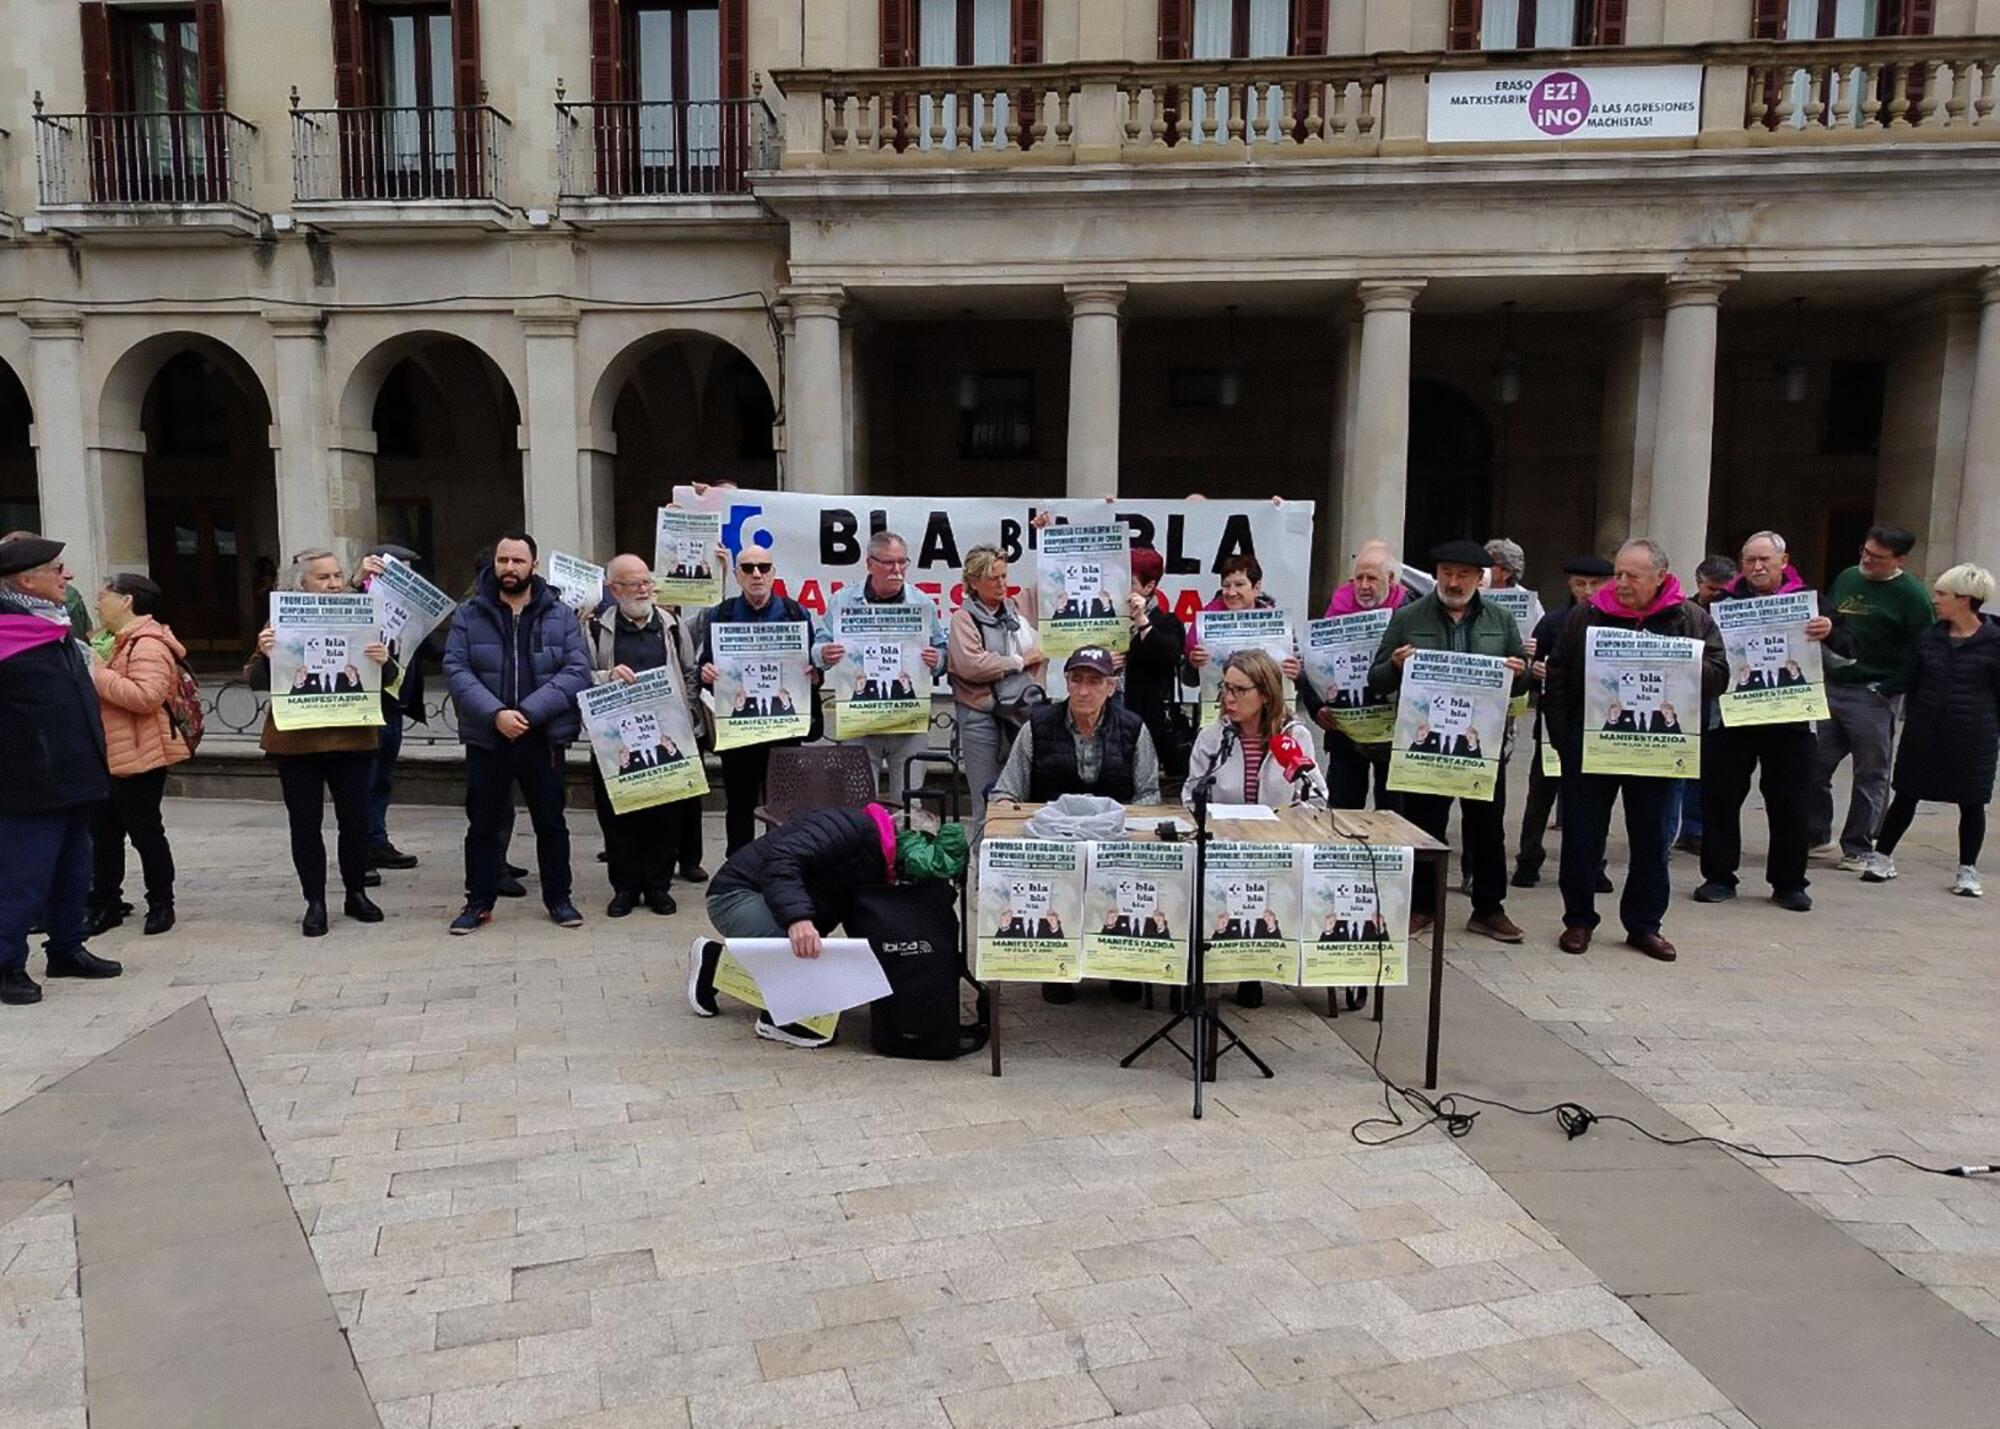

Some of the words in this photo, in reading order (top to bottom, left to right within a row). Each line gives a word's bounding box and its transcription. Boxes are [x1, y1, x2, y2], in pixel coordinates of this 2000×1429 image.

[1495, 80, 1533, 91] ERASO
[1543, 81, 1578, 101] EZ!
[1450, 94, 1528, 105] MATXISTARIK
[1591, 104, 1599, 114] A
[1602, 103, 1622, 114] LAS
[1624, 101, 1695, 113] AGRESIONES
[1587, 116, 1653, 128] MACHISTAS!
[1600, 733, 1687, 744] MANIFESTAZIOA
[1405, 752, 1486, 768] MANIFESTAZIOA
[1135, 882, 1155, 892] bla
[992, 940, 1068, 948] MANIFESTAZIOA
[1097, 937, 1175, 949] MANIFESTAZIOA
